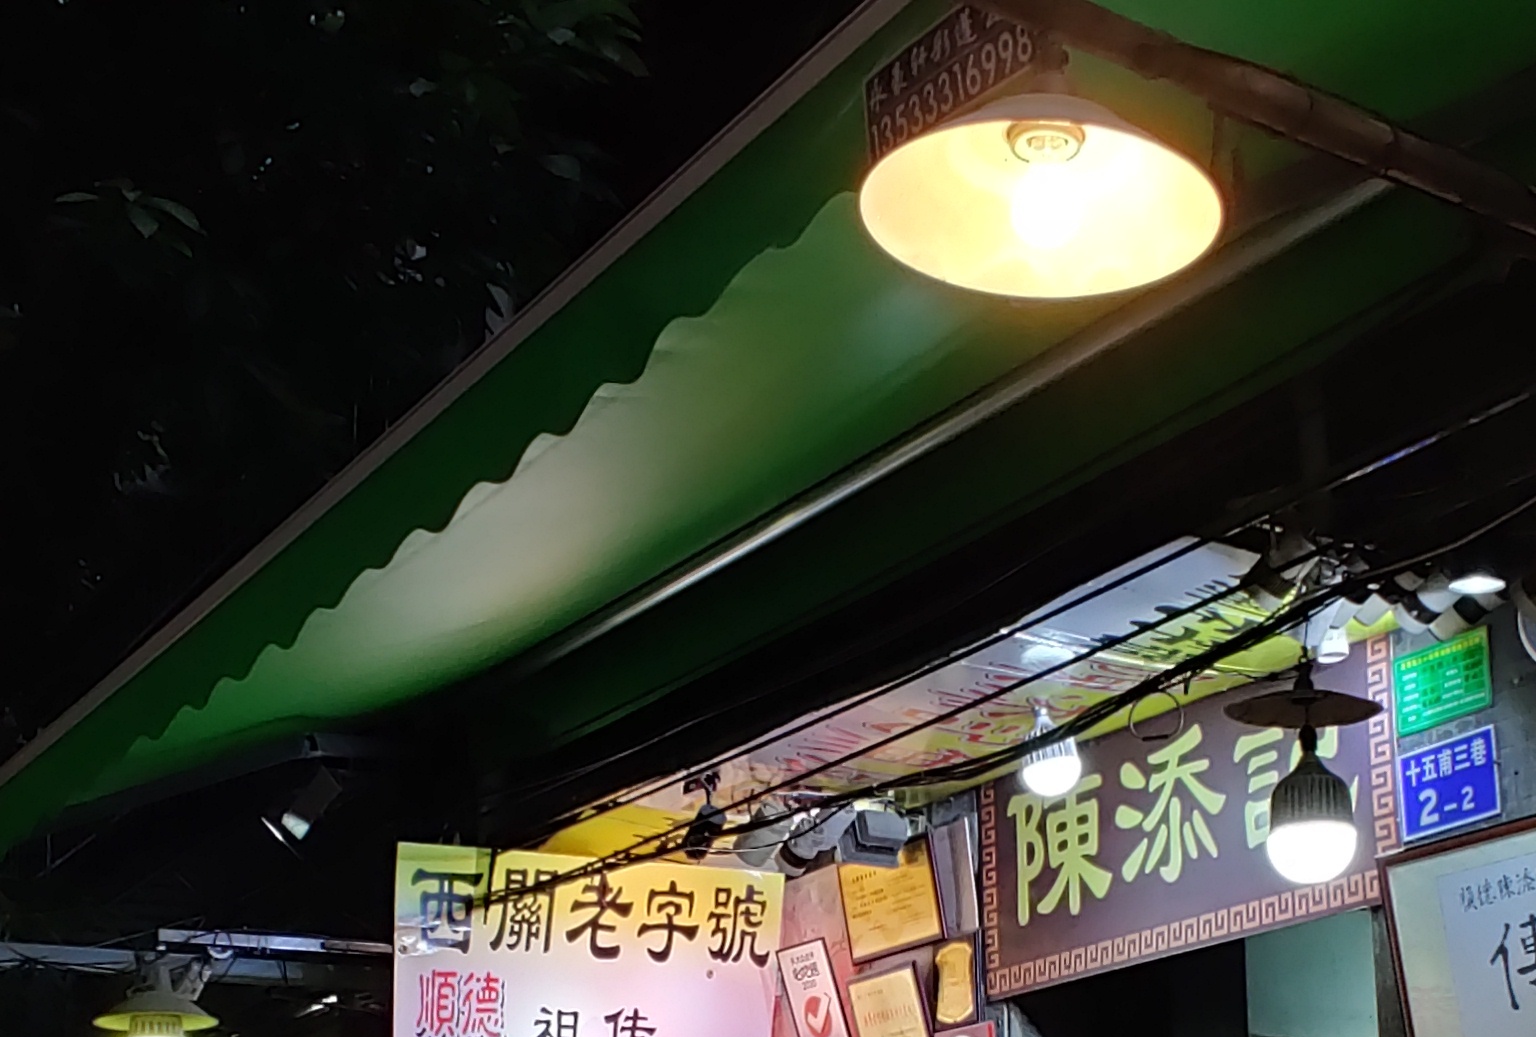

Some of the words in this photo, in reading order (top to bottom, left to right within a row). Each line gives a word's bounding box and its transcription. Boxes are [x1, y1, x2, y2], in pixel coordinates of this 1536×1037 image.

[411, 867, 775, 970] 西關老字號
